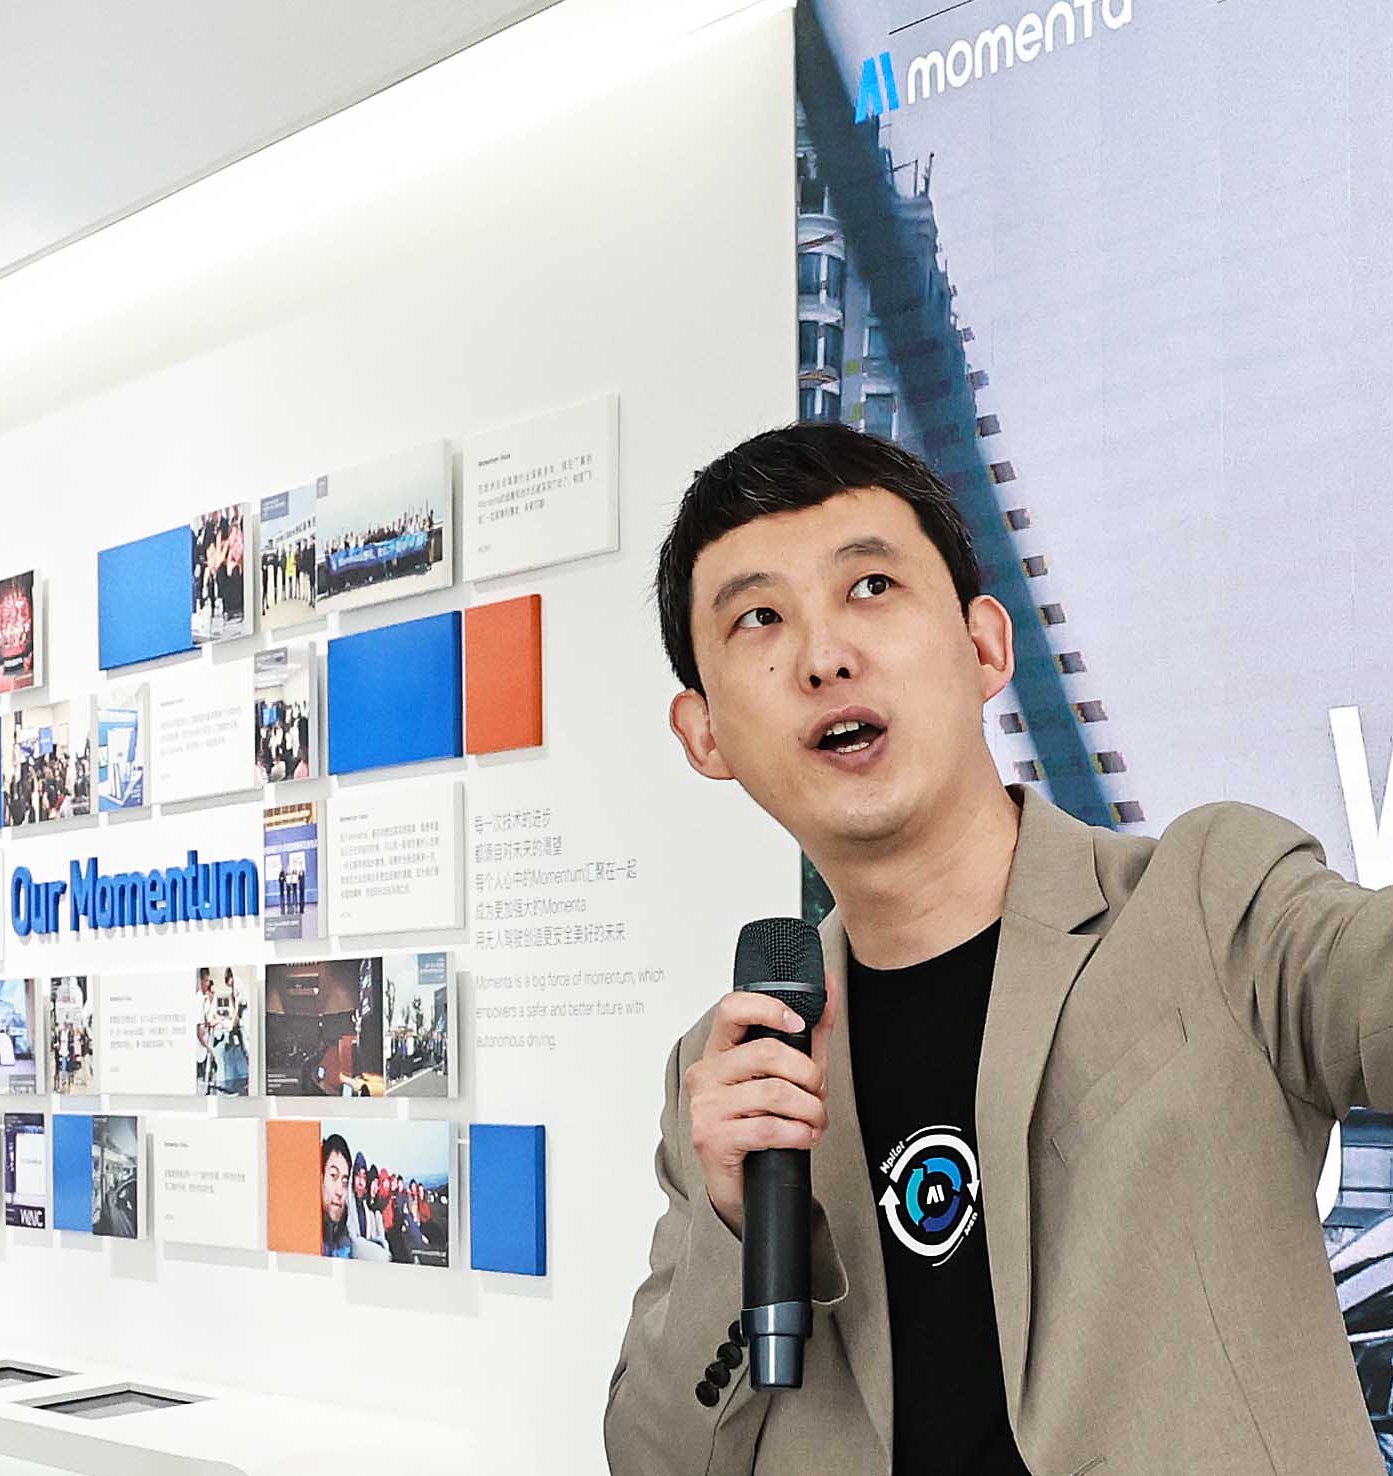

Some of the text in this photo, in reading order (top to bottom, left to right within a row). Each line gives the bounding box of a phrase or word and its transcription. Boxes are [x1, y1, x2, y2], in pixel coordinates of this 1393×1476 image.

[11, 866, 67, 936] Our
[70, 850, 260, 931] Momentum
[880, 1141, 905, 1174] Mpilot
